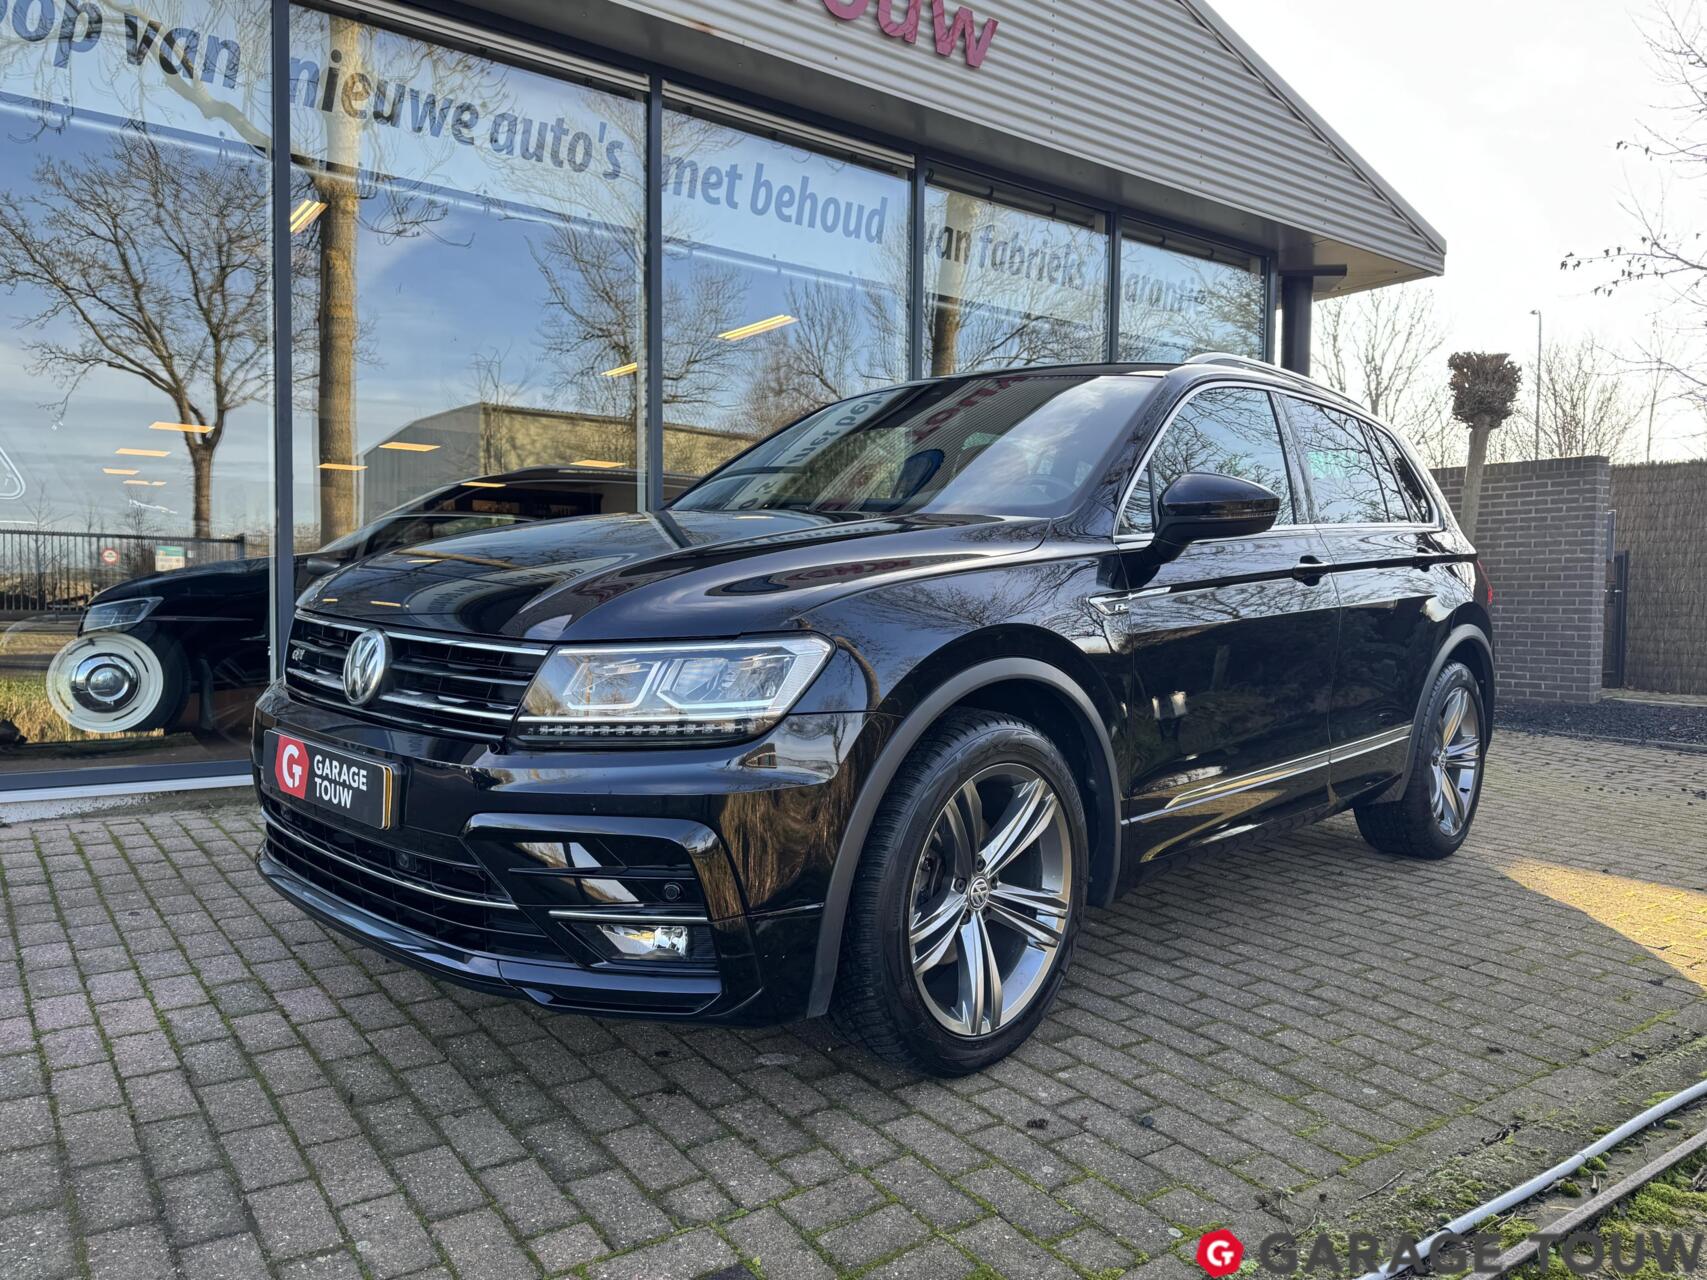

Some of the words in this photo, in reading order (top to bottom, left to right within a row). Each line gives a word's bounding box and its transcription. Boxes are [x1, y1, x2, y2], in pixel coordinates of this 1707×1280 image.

[0, 0, 103, 69] op
[124, 12, 241, 89] van
[290, 49, 479, 145] nieuwe
[490, 112, 624, 180] auto's
[662, 154, 743, 210] met
[750, 162, 888, 244] behoud
[313, 754, 367, 791] GARAGE
[314, 777, 353, 808] TOUW
